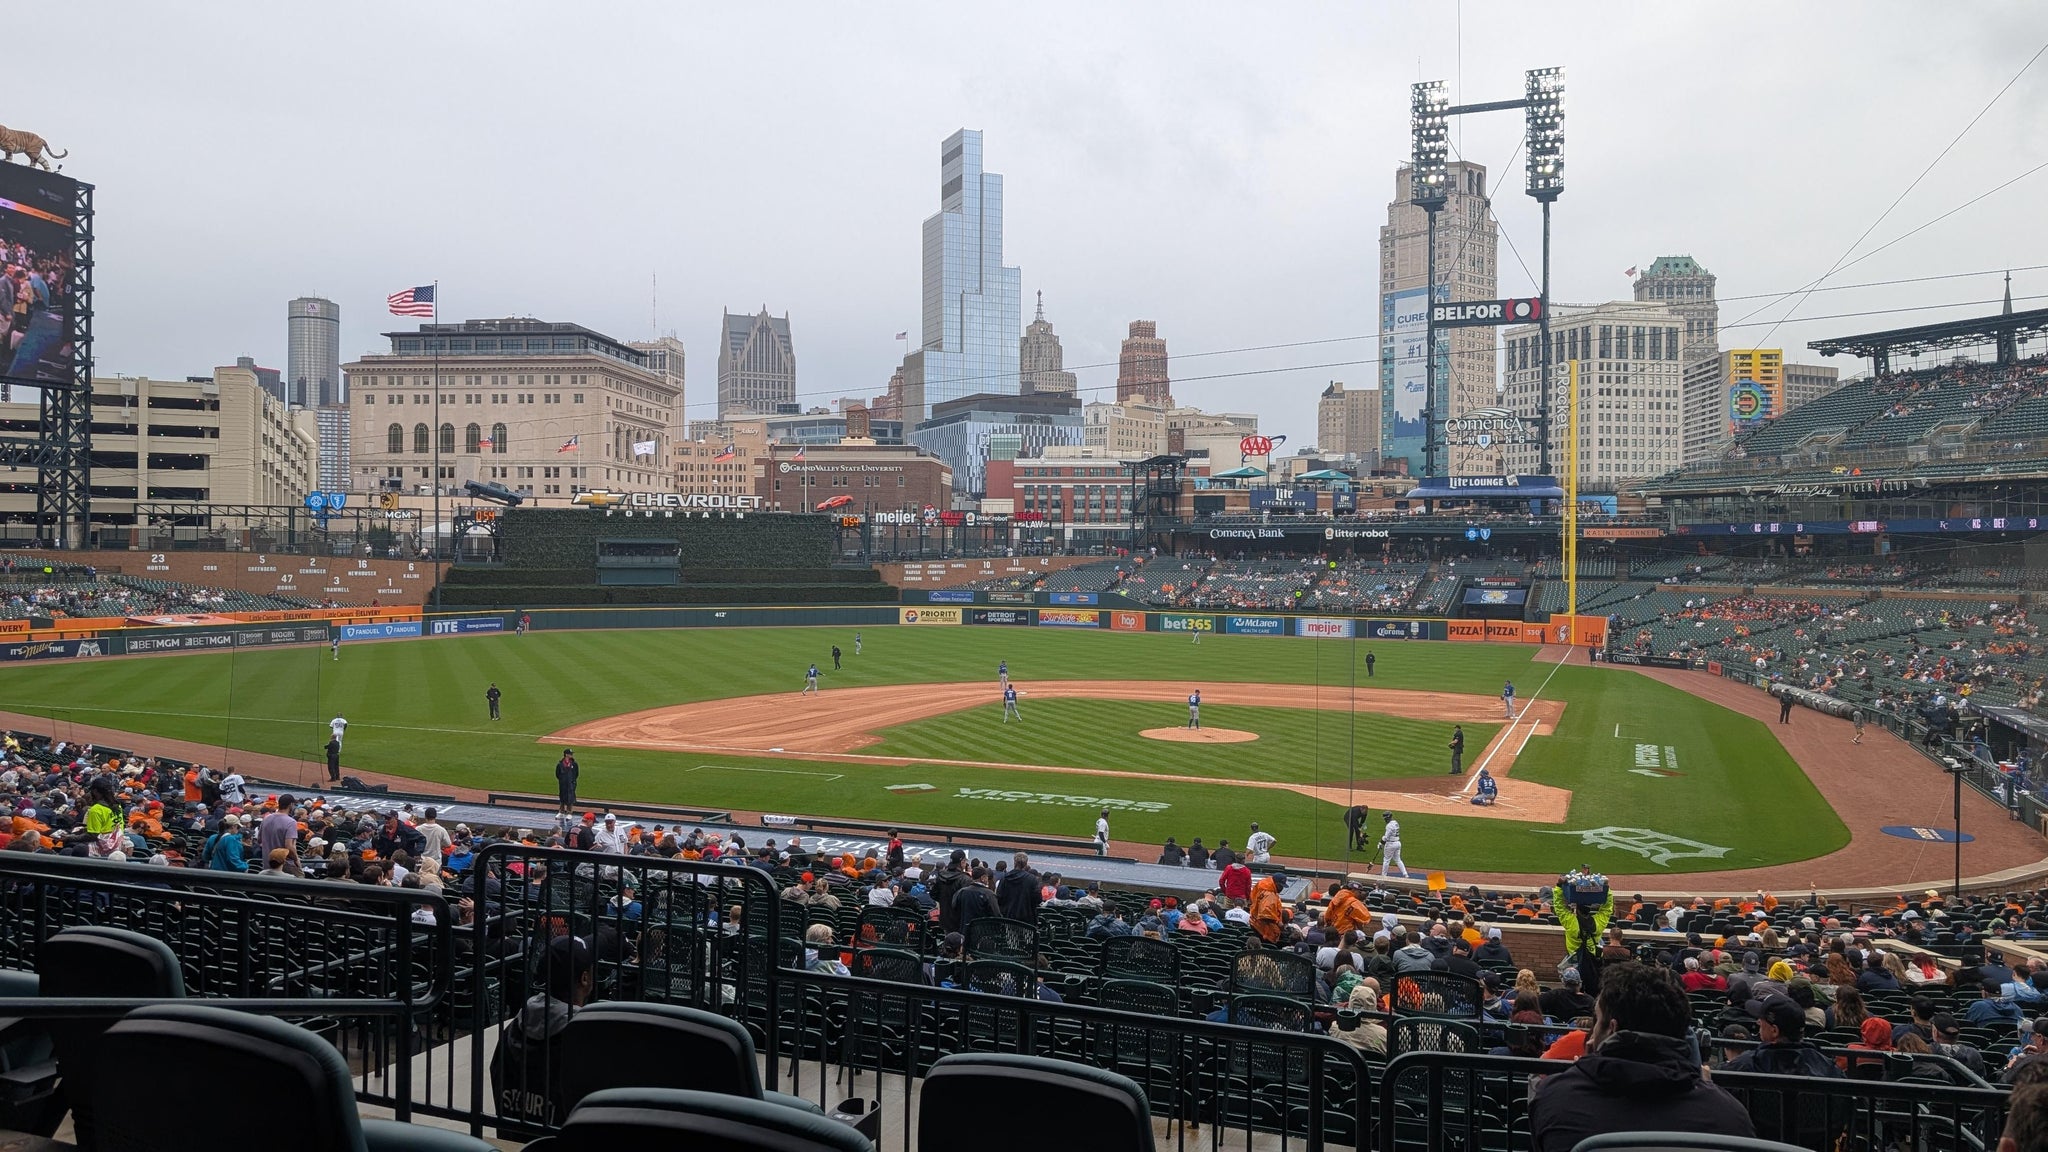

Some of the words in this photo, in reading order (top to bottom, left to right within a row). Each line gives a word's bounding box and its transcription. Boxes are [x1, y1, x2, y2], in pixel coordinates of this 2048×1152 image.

[1433, 304, 1502, 321] BELFOR
[1397, 312, 1425, 324] CURE
[1408, 344, 1421, 358] #1
[1556, 376, 1570, 429] Rocket
[1445, 435, 1525, 445] LANDING
[1242, 437, 1269, 455] AAA
[1450, 477, 1468, 489] Lite
[1469, 478, 1503, 486] LOUNGE
[1842, 483, 1872, 493] TIGER
[1883, 481, 1908, 491] CLUB
[1275, 488, 1293, 501] Lite
[632, 493, 763, 509] CHEVROLET
[606, 510, 744, 519] FOUNTAIN
[875, 510, 917, 526] meijer
[1258, 528, 1285, 537] Bank
[151, 554, 165, 563] 23
[259, 555, 265, 564] 5
[310, 558, 316, 566] 2
[1040, 558, 1049, 566] 42
[358, 560, 367, 568] 16
[408, 563, 414, 571] 6
[983, 561, 991, 569] 10
[281, 574, 293, 583] 47
[333, 576, 340, 585] 3
[388, 578, 392, 586] 1
[1044, 613, 1076, 623] Surfside
[1121, 614, 1135, 627] hap
[1164, 616, 1212, 630] bet365
[1245, 618, 1278, 628] McLaren
[434, 621, 458, 634] DTE
[1307, 621, 1343, 635] meijer
[1377, 628, 1405, 637] Corona
[1450, 626, 1483, 635] PIZZA!
[1486, 626, 1519, 636] PIZZA!
[138, 638, 180, 649] BETMGM
[193, 635, 231, 647] BETMGM
[50, 645, 64, 653] TIME
[225, 783, 236, 793] 22
[952, 794, 1018, 802] HOME
[1025, 800, 1160, 813] SOLUTIONS
[958, 787, 1172, 810] VICTORS
